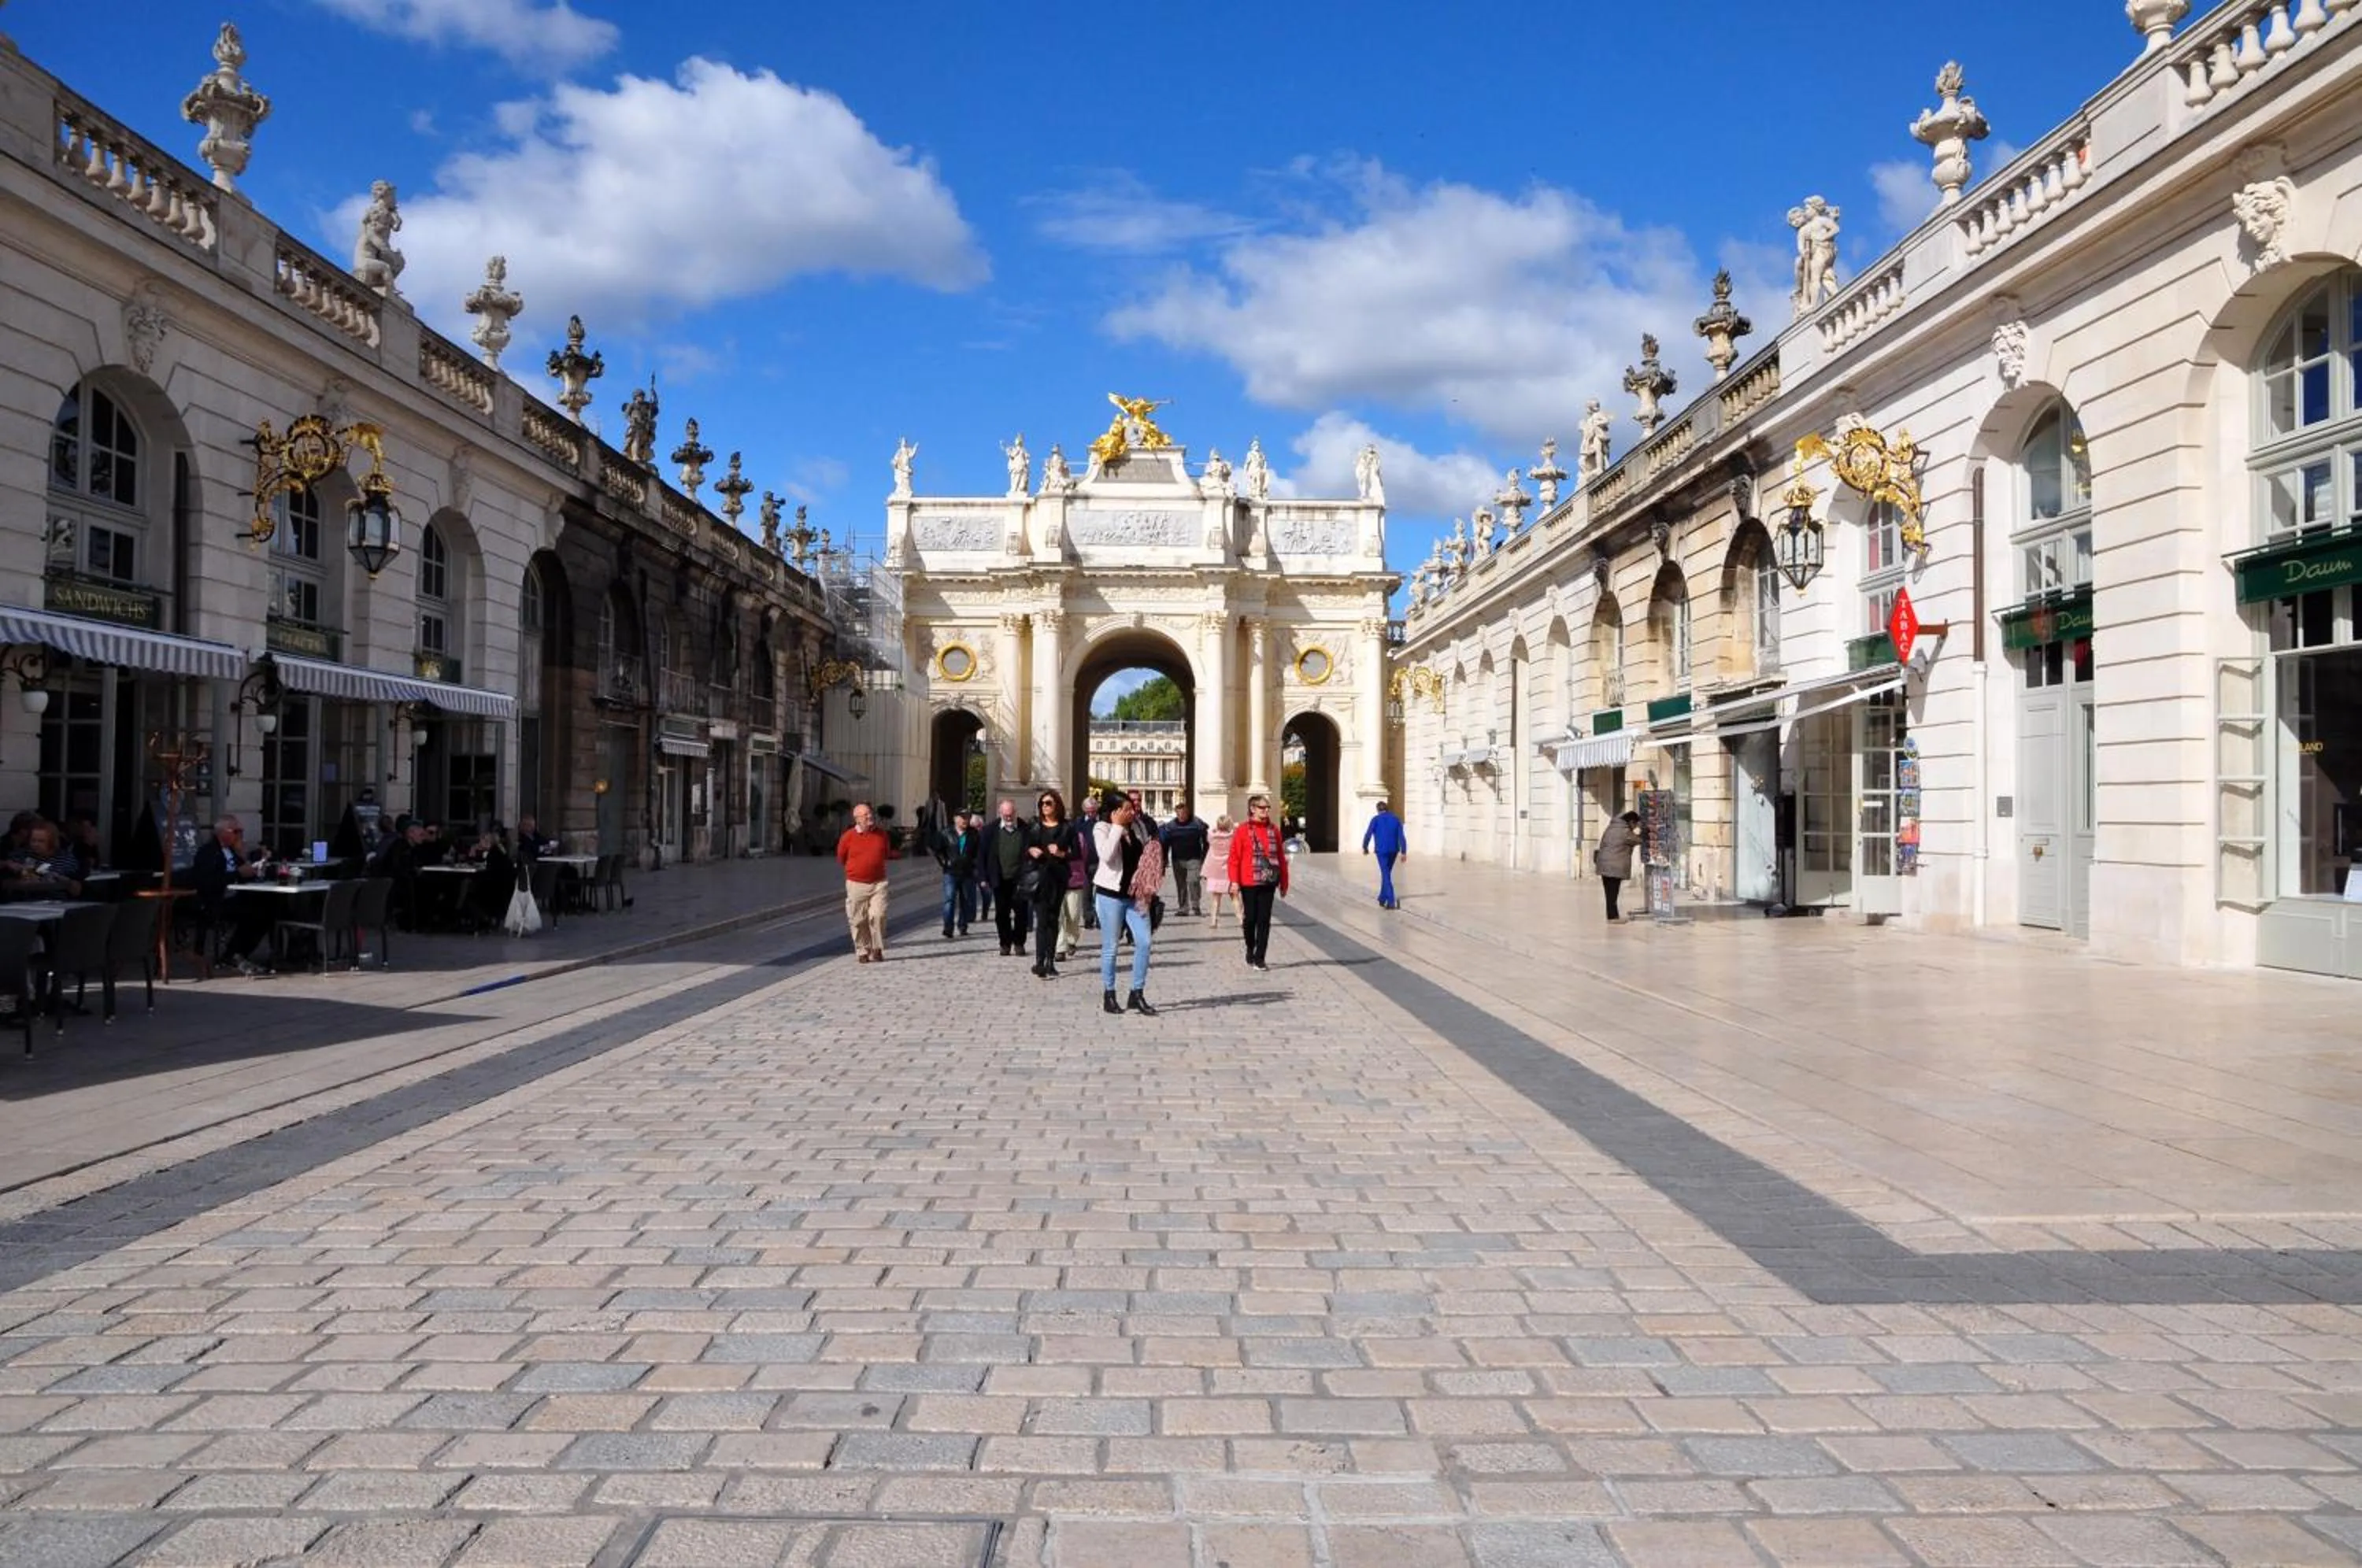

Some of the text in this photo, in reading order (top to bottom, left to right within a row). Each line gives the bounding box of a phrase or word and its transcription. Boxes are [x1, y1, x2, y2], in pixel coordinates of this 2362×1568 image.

[2280, 560, 2353, 582] Daum
[1898, 598, 1909, 653] TABAC
[2056, 611, 2093, 631] Dau
